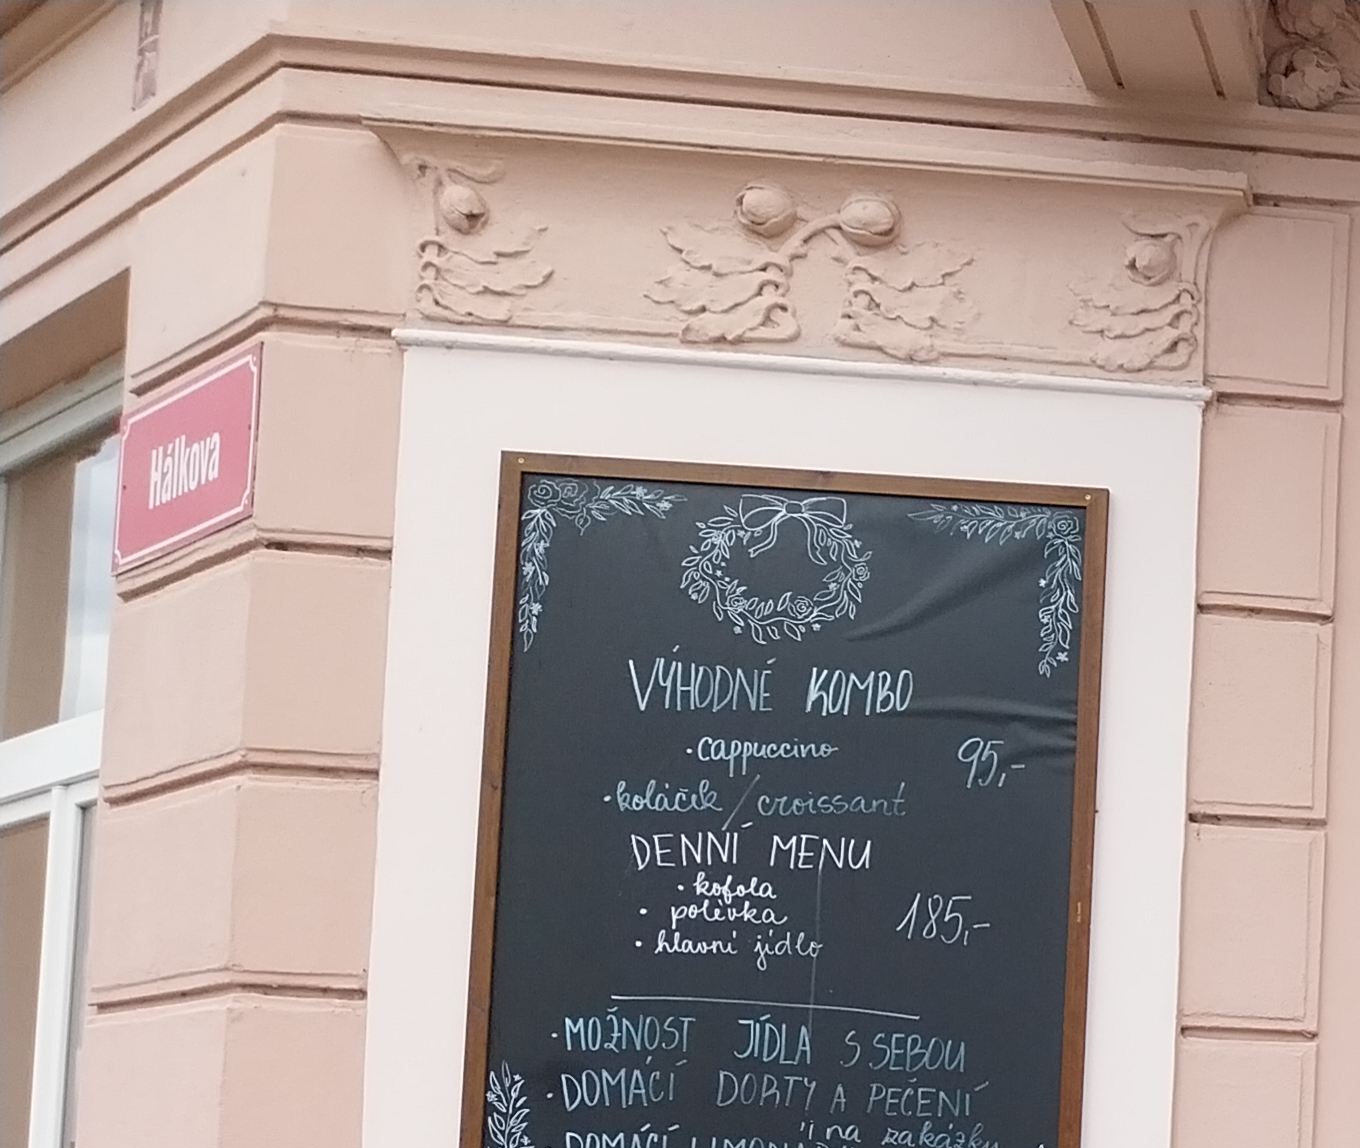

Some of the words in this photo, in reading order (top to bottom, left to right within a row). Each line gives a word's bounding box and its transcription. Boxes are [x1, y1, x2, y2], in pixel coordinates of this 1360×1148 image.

[148, 431, 221, 510] Hálkova
[628, 645, 777, 712] VÝHODNÉ
[806, 666, 914, 716] KOMBO
[697, 737, 839, 777] cappuccino
[616, 782, 724, 813] koláček
[757, 781, 907, 817] croissant
[630, 822, 754, 869] DENNÍ
[769, 835, 872, 870] MENU
[694, 872, 777, 903] kofola
[670, 899, 788, 929] polévka
[655, 930, 738, 954] hlavní
[754, 929, 823, 970] jídlo
[564, 1006, 696, 1054] MOŽNOST
[732, 1013, 813, 1065] JÍDLA
[841, 1030, 861, 1067] S
[873, 1034, 967, 1074] SEBOU
[561, 1055, 689, 1109] DOMÁCÍ
[716, 1069, 817, 1115] DORTY
[830, 1084, 848, 1114] A
[867, 1077, 990, 1119] PEČENÍ
[825, 1124, 862, 1144] na
